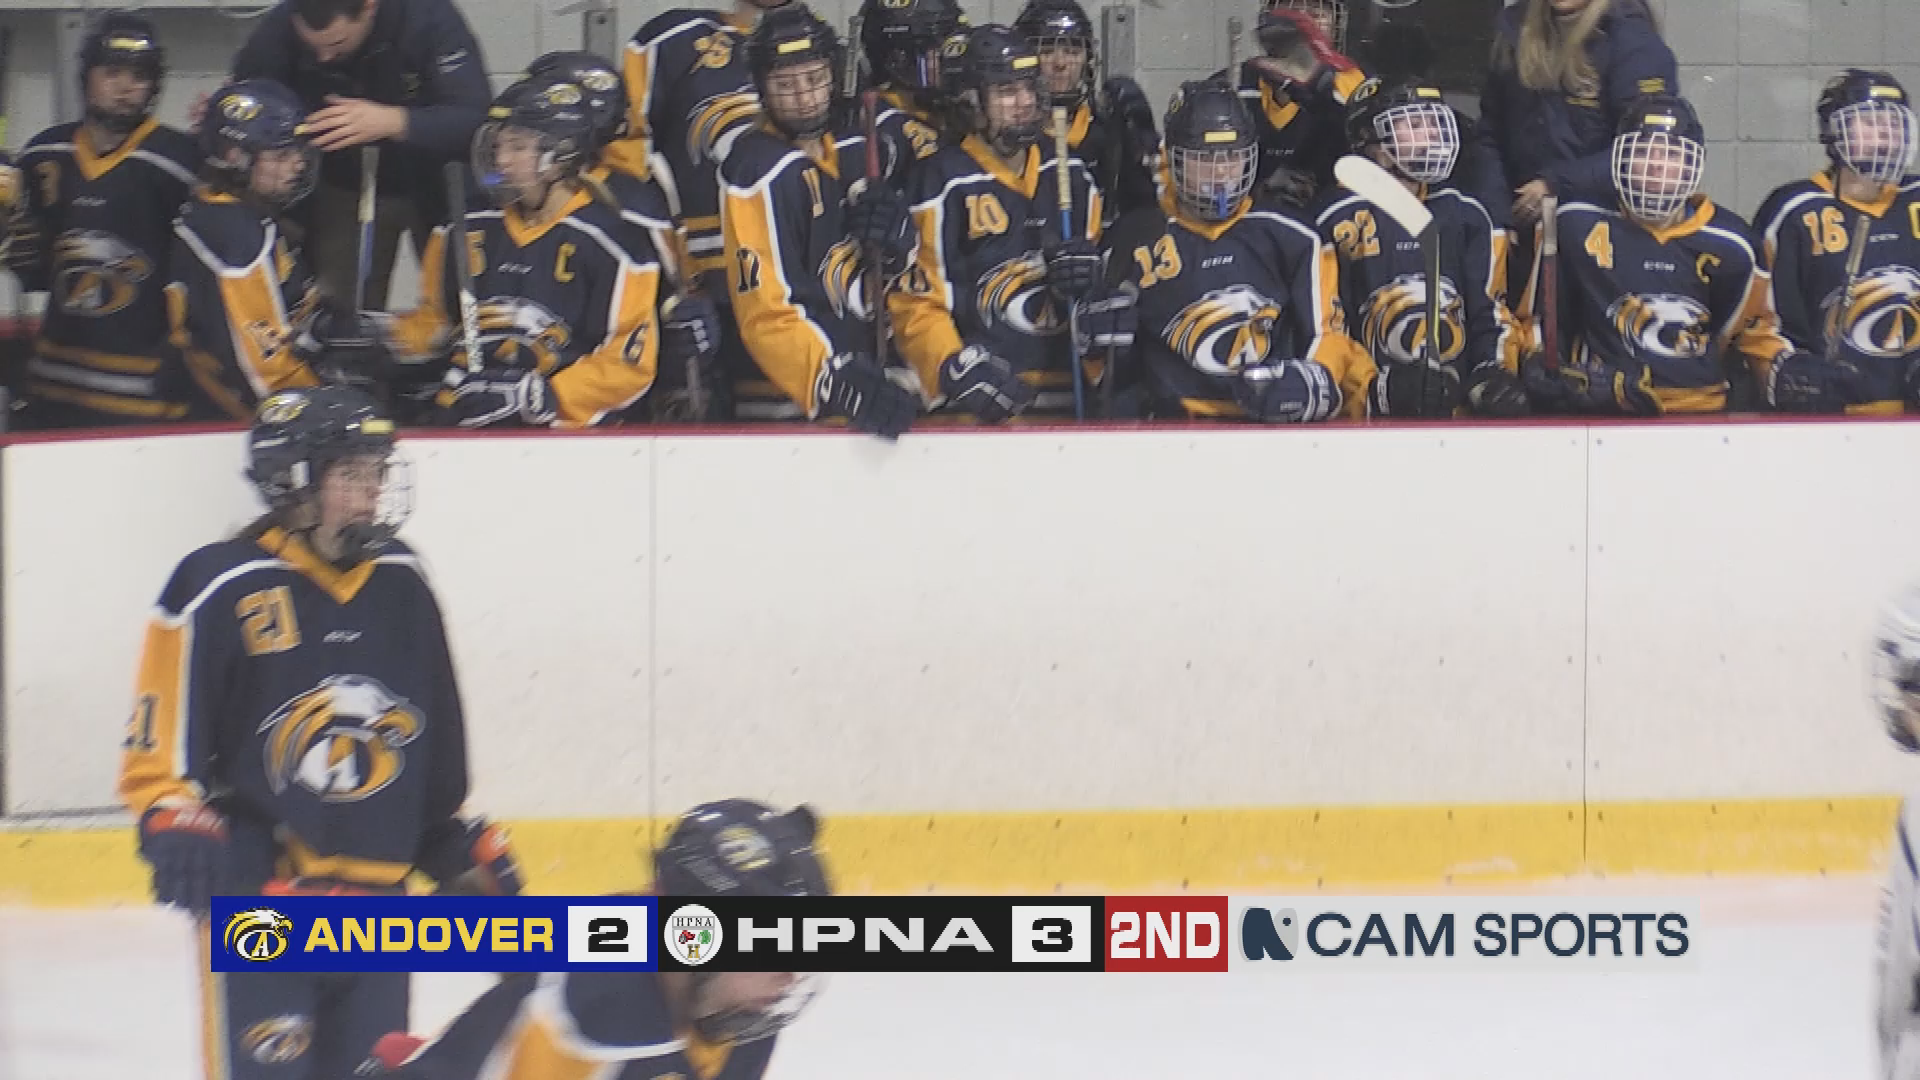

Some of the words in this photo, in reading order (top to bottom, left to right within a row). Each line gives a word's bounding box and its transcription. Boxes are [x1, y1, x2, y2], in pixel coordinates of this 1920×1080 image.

[965, 194, 1009, 238] 10
[1334, 210, 1380, 260] 22
[1803, 206, 1849, 256] 16
[554, 243, 576, 282] C
[1134, 234, 1182, 288] 13
[1584, 221, 1613, 269] 4
[1696, 252, 1721, 284] C
[622, 320, 650, 366] 6
[235, 585, 301, 656] 21
